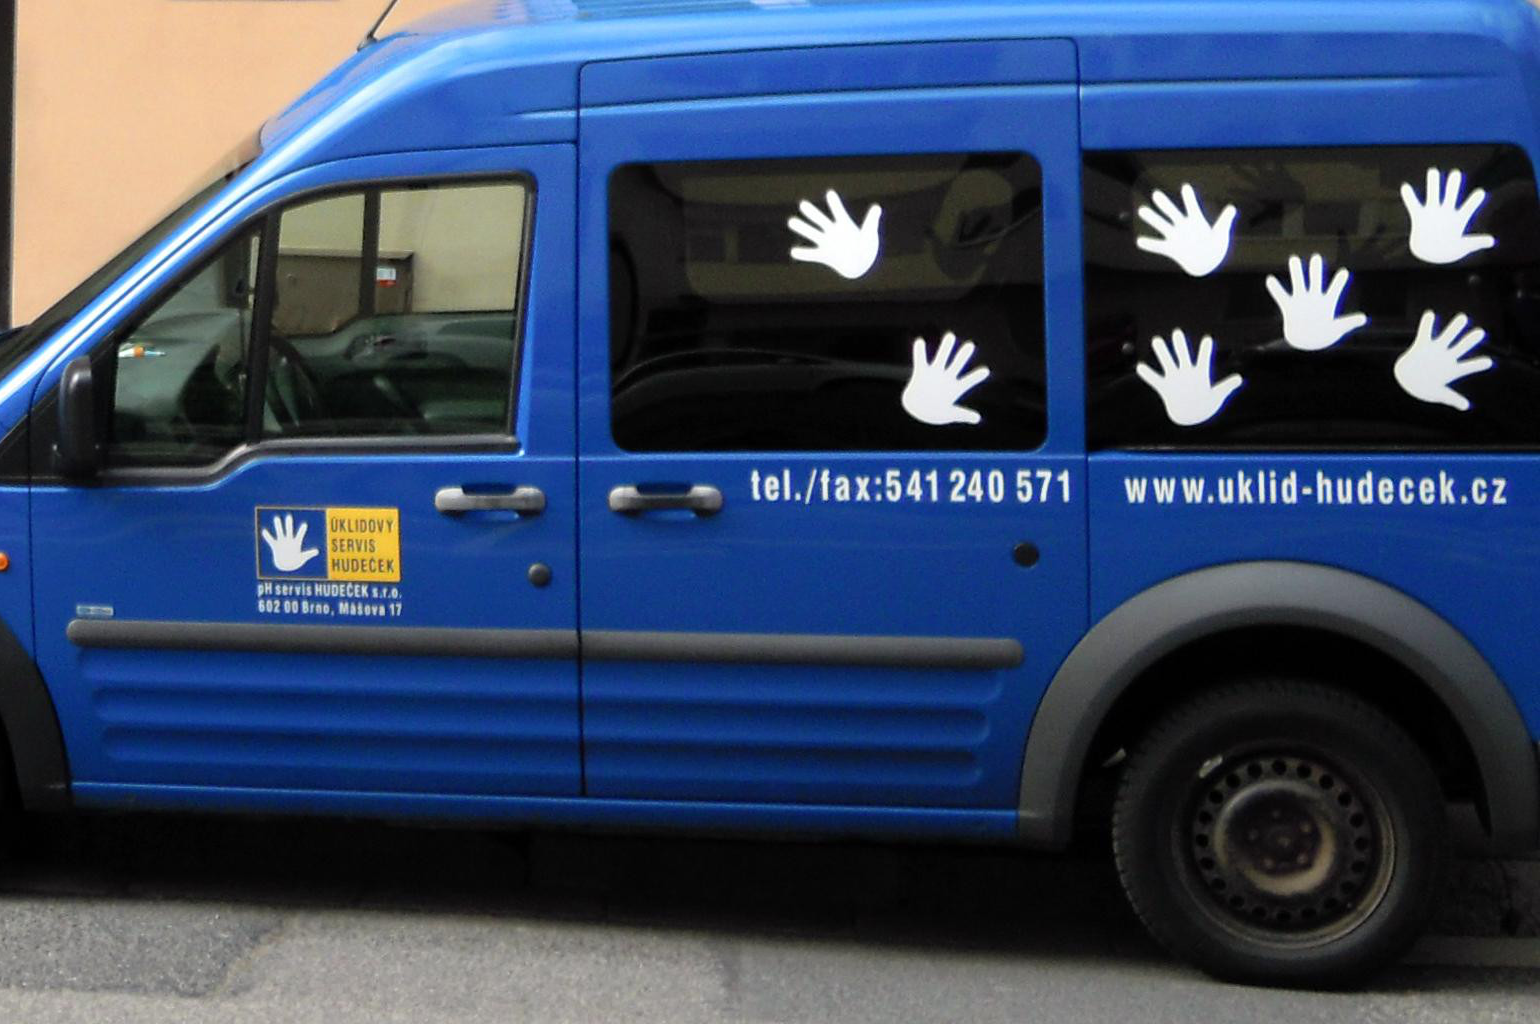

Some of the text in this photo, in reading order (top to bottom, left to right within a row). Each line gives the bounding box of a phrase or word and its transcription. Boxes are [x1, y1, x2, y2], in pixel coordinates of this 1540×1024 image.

[949, 469, 1005, 503] 240
[1016, 469, 1071, 503] 571
[1124, 470, 1508, 505] www.uklid-hudecek.cz
[331, 516, 394, 533] ÚKLIDOVÝ
[331, 539, 376, 553] SERVIS
[331, 557, 395, 573] HUDEČEK
[257, 582, 272, 597] pH
[275, 583, 313, 596] servis
[315, 582, 369, 597] HUDEČEK
[258, 600, 280, 613] 602
[284, 600, 299, 613] 00
[302, 600, 335, 616] Brno,
[389, 603, 403, 616] 17
